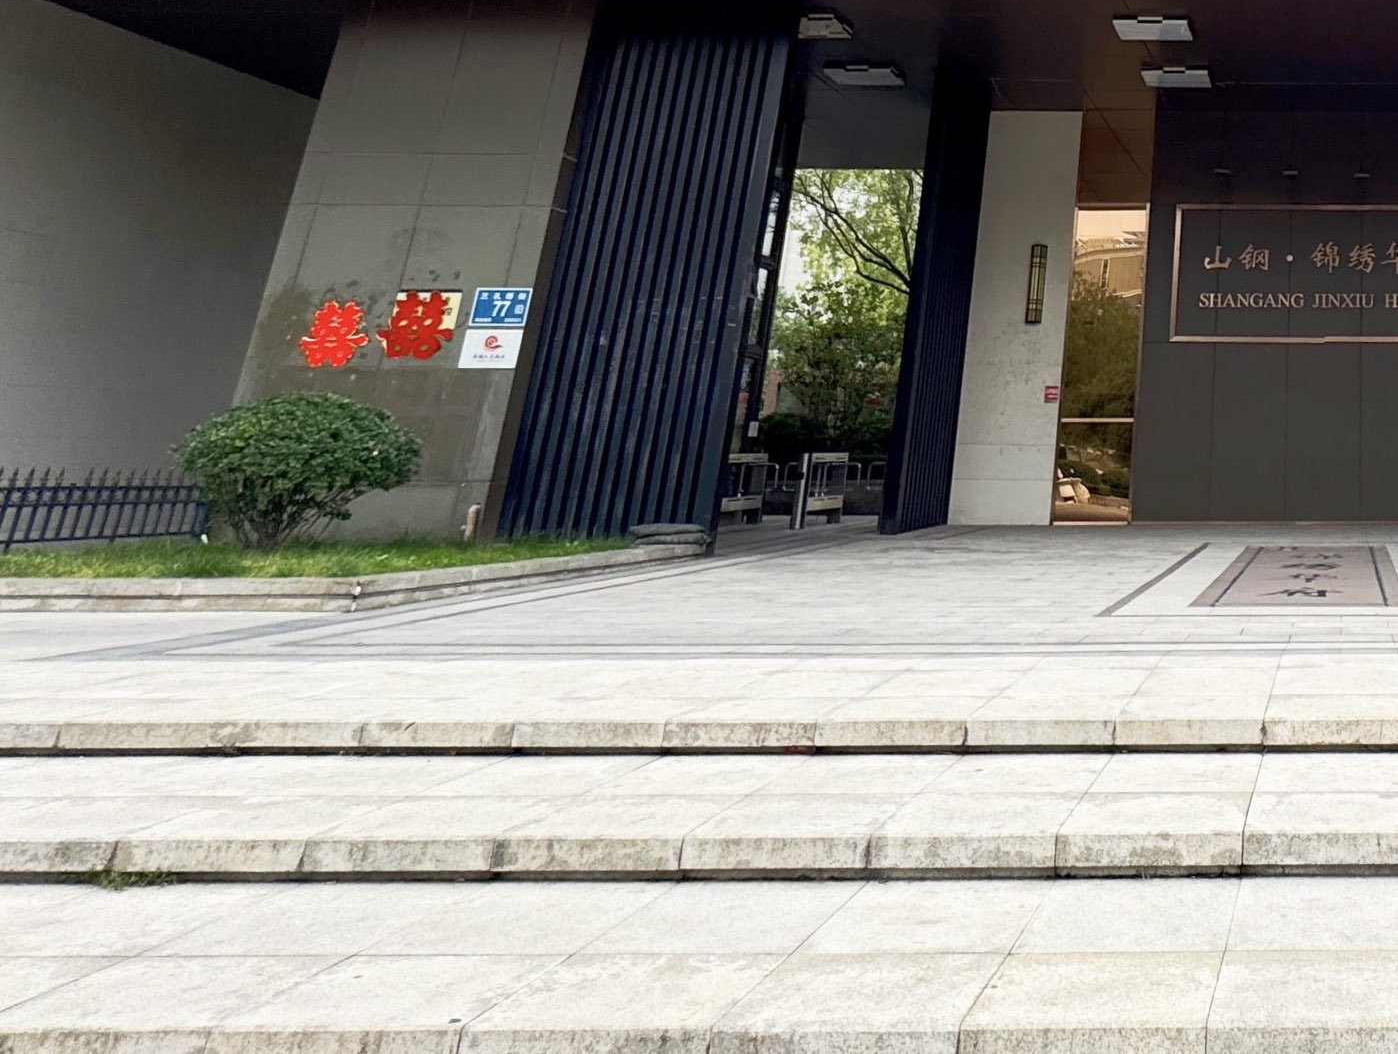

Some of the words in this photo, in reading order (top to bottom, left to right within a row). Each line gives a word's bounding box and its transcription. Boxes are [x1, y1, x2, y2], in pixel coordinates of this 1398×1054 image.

[491, 300, 512, 317] 77
[1199, 293, 1304, 309] SHANGANG
[1312, 293, 1375, 309] JINXIU
